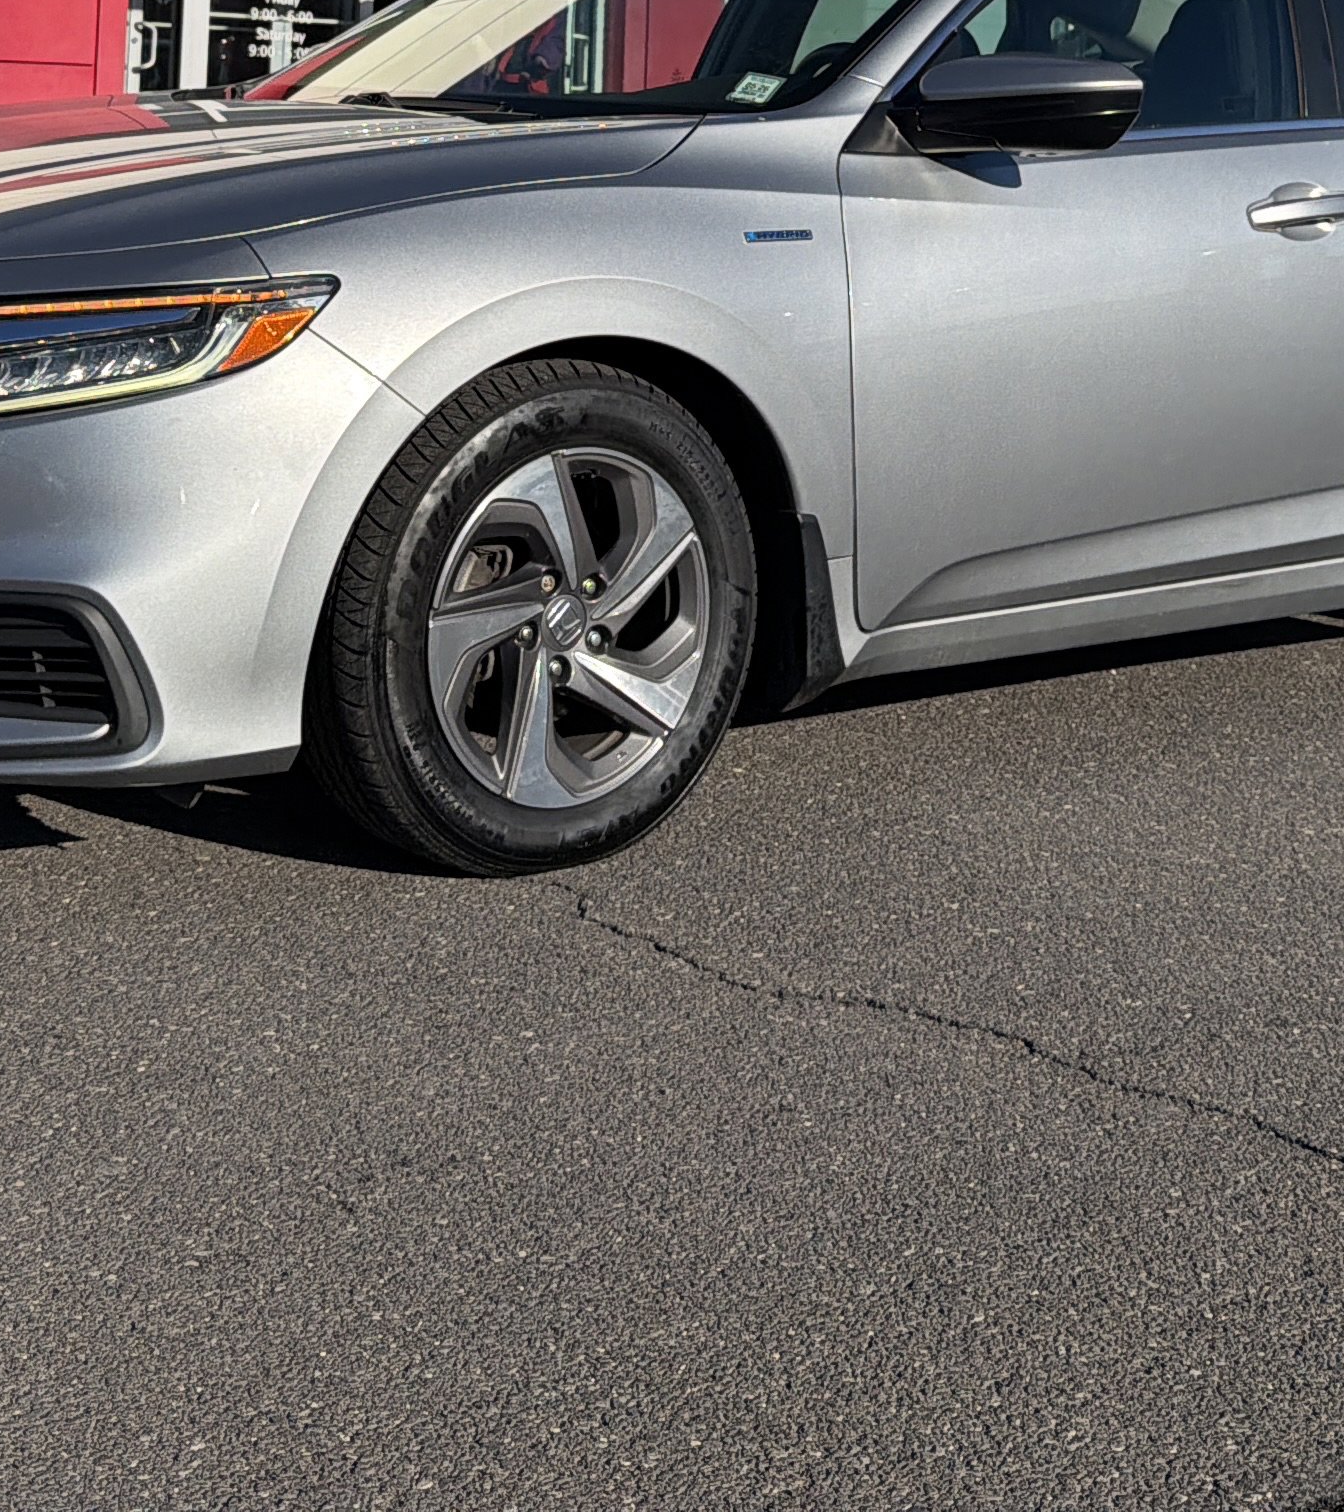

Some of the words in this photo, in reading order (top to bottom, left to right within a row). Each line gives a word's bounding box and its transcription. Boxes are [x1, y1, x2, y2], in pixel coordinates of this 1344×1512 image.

[250, 7, 277, 22] 9:00
[255, 27, 306, 45] Saturday
[248, 44, 275, 58] 9:00
